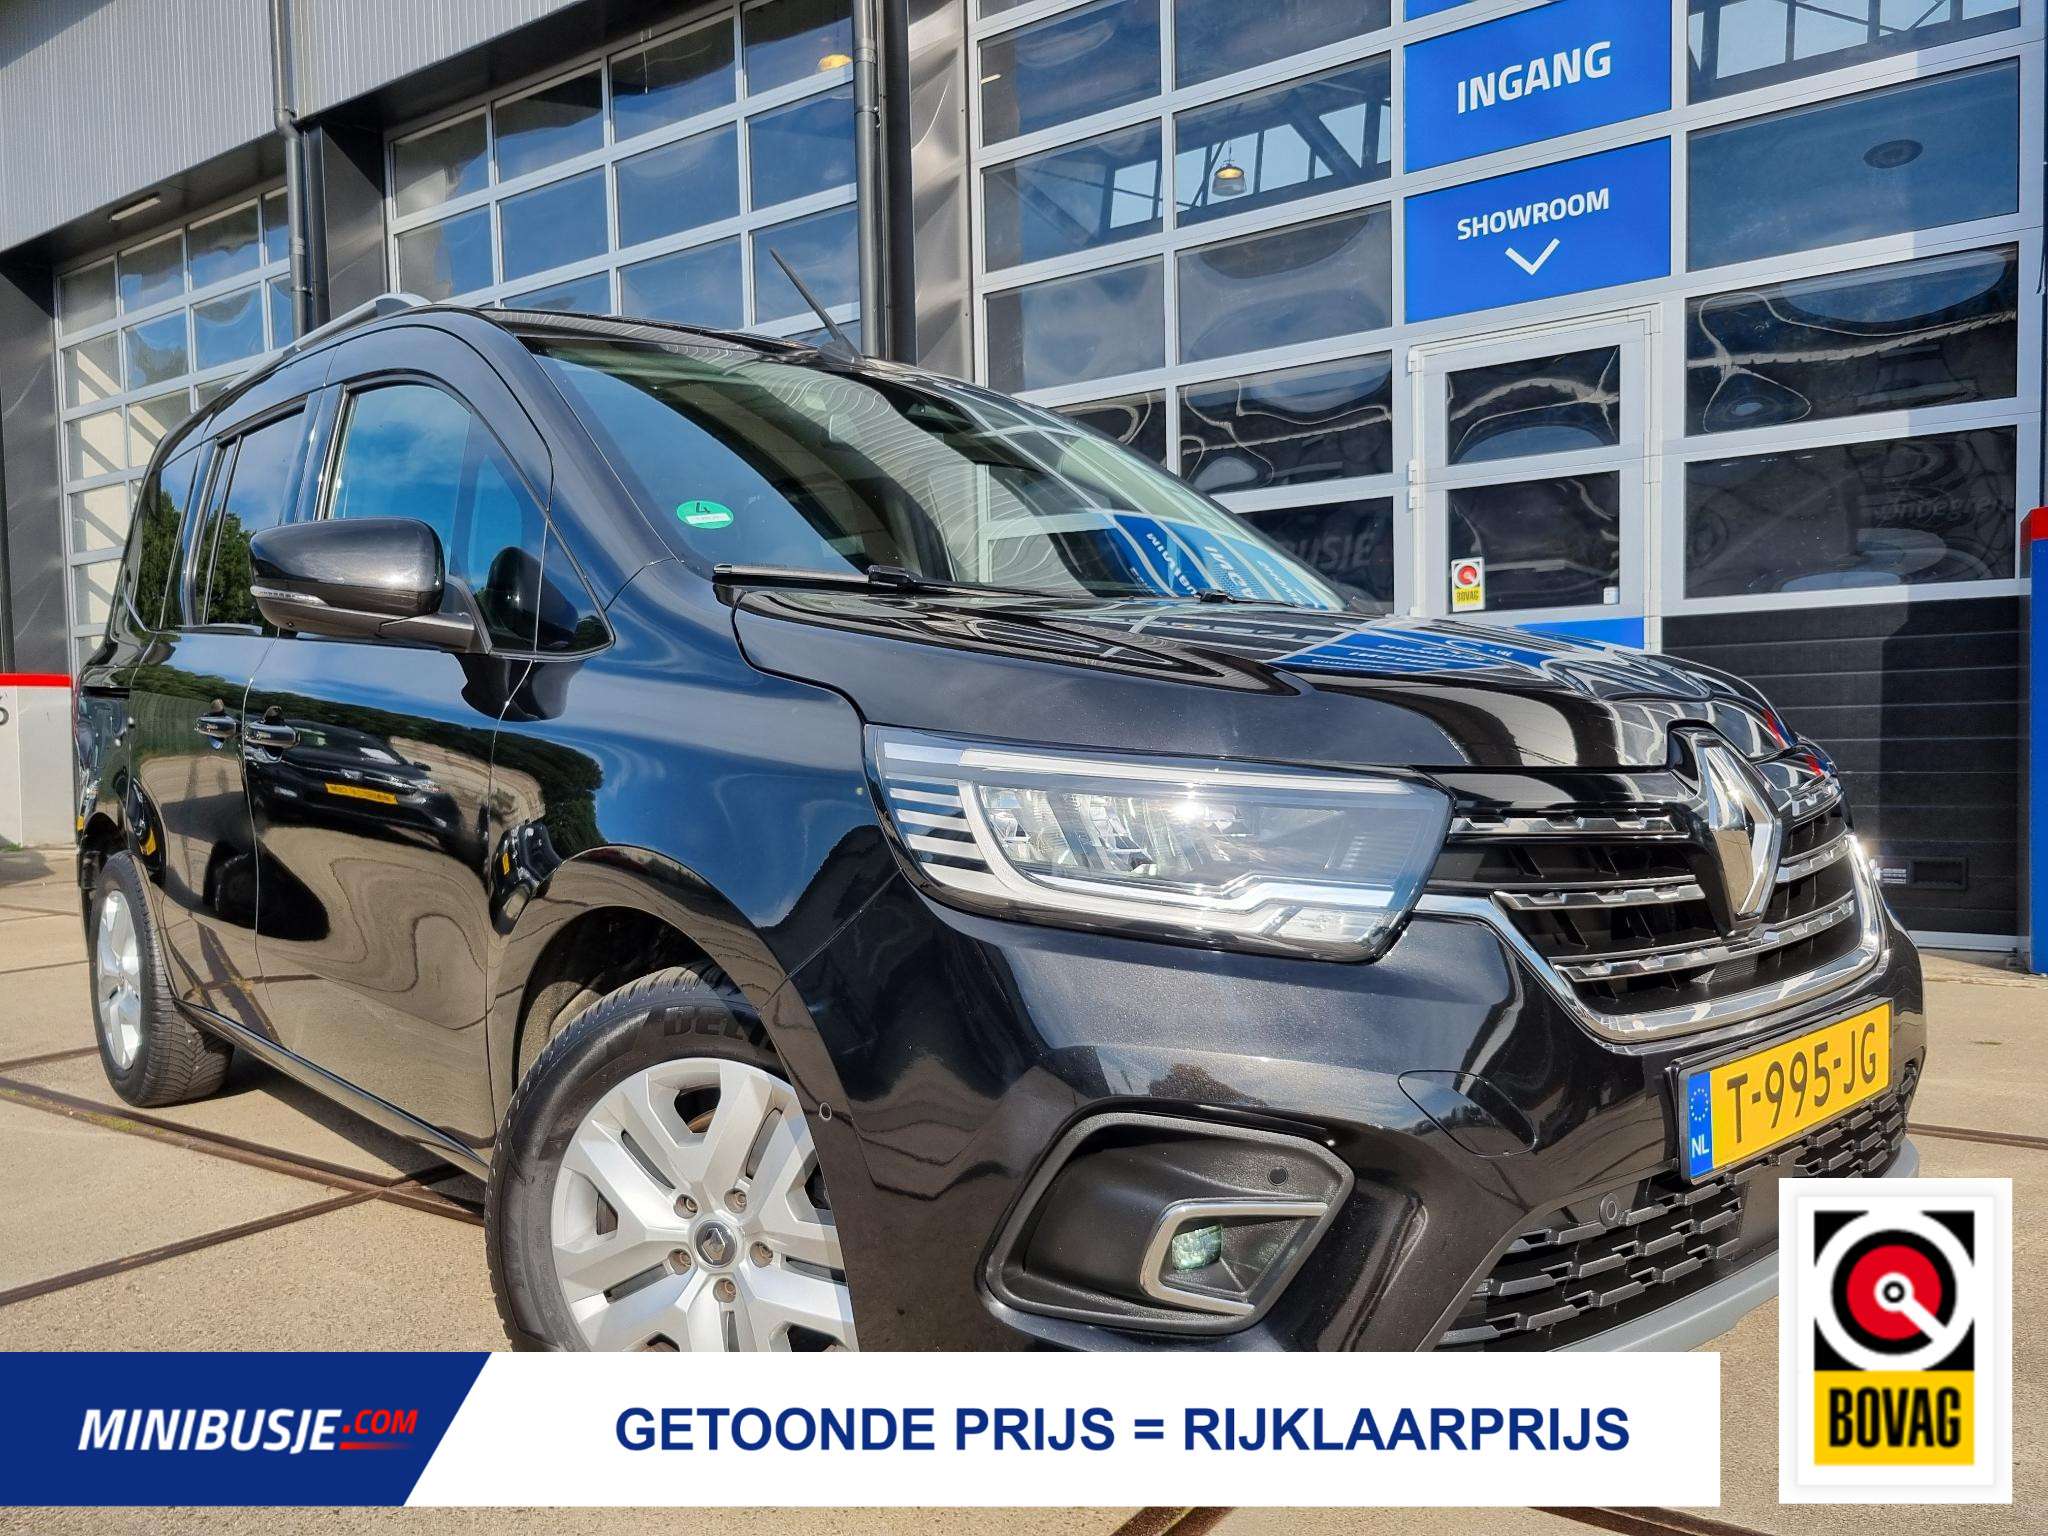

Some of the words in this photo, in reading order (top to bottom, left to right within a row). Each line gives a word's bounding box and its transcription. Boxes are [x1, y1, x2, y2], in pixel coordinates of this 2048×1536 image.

[1457, 40, 1611, 115] INGANG
[1457, 187, 1610, 241] SHOWROOM
[1690, 1133, 1710, 1158] NL
[1726, 1022, 1876, 1144] T-995-JG
